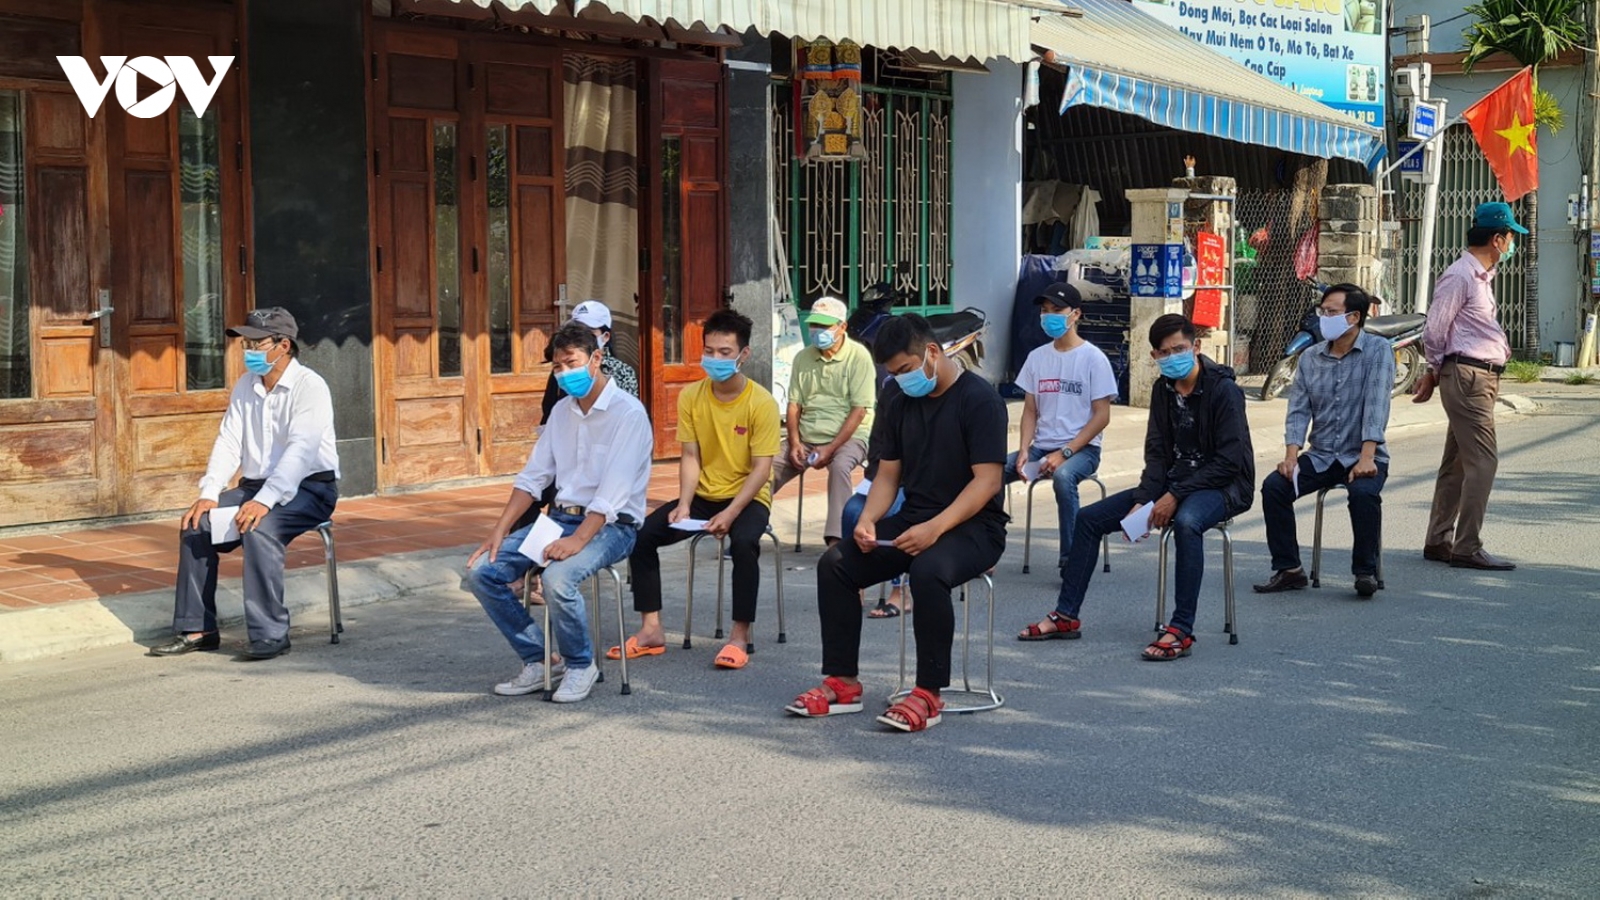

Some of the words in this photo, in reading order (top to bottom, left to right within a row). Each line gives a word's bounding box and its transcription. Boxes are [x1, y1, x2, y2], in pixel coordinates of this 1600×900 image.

[1239, 9, 1257, 29] Bọc
[1280, 15, 1302, 34] Loại
[1305, 17, 1332, 35] Salon
[1206, 29, 1226, 46] Mui
[1342, 46, 1354, 60] Xe
